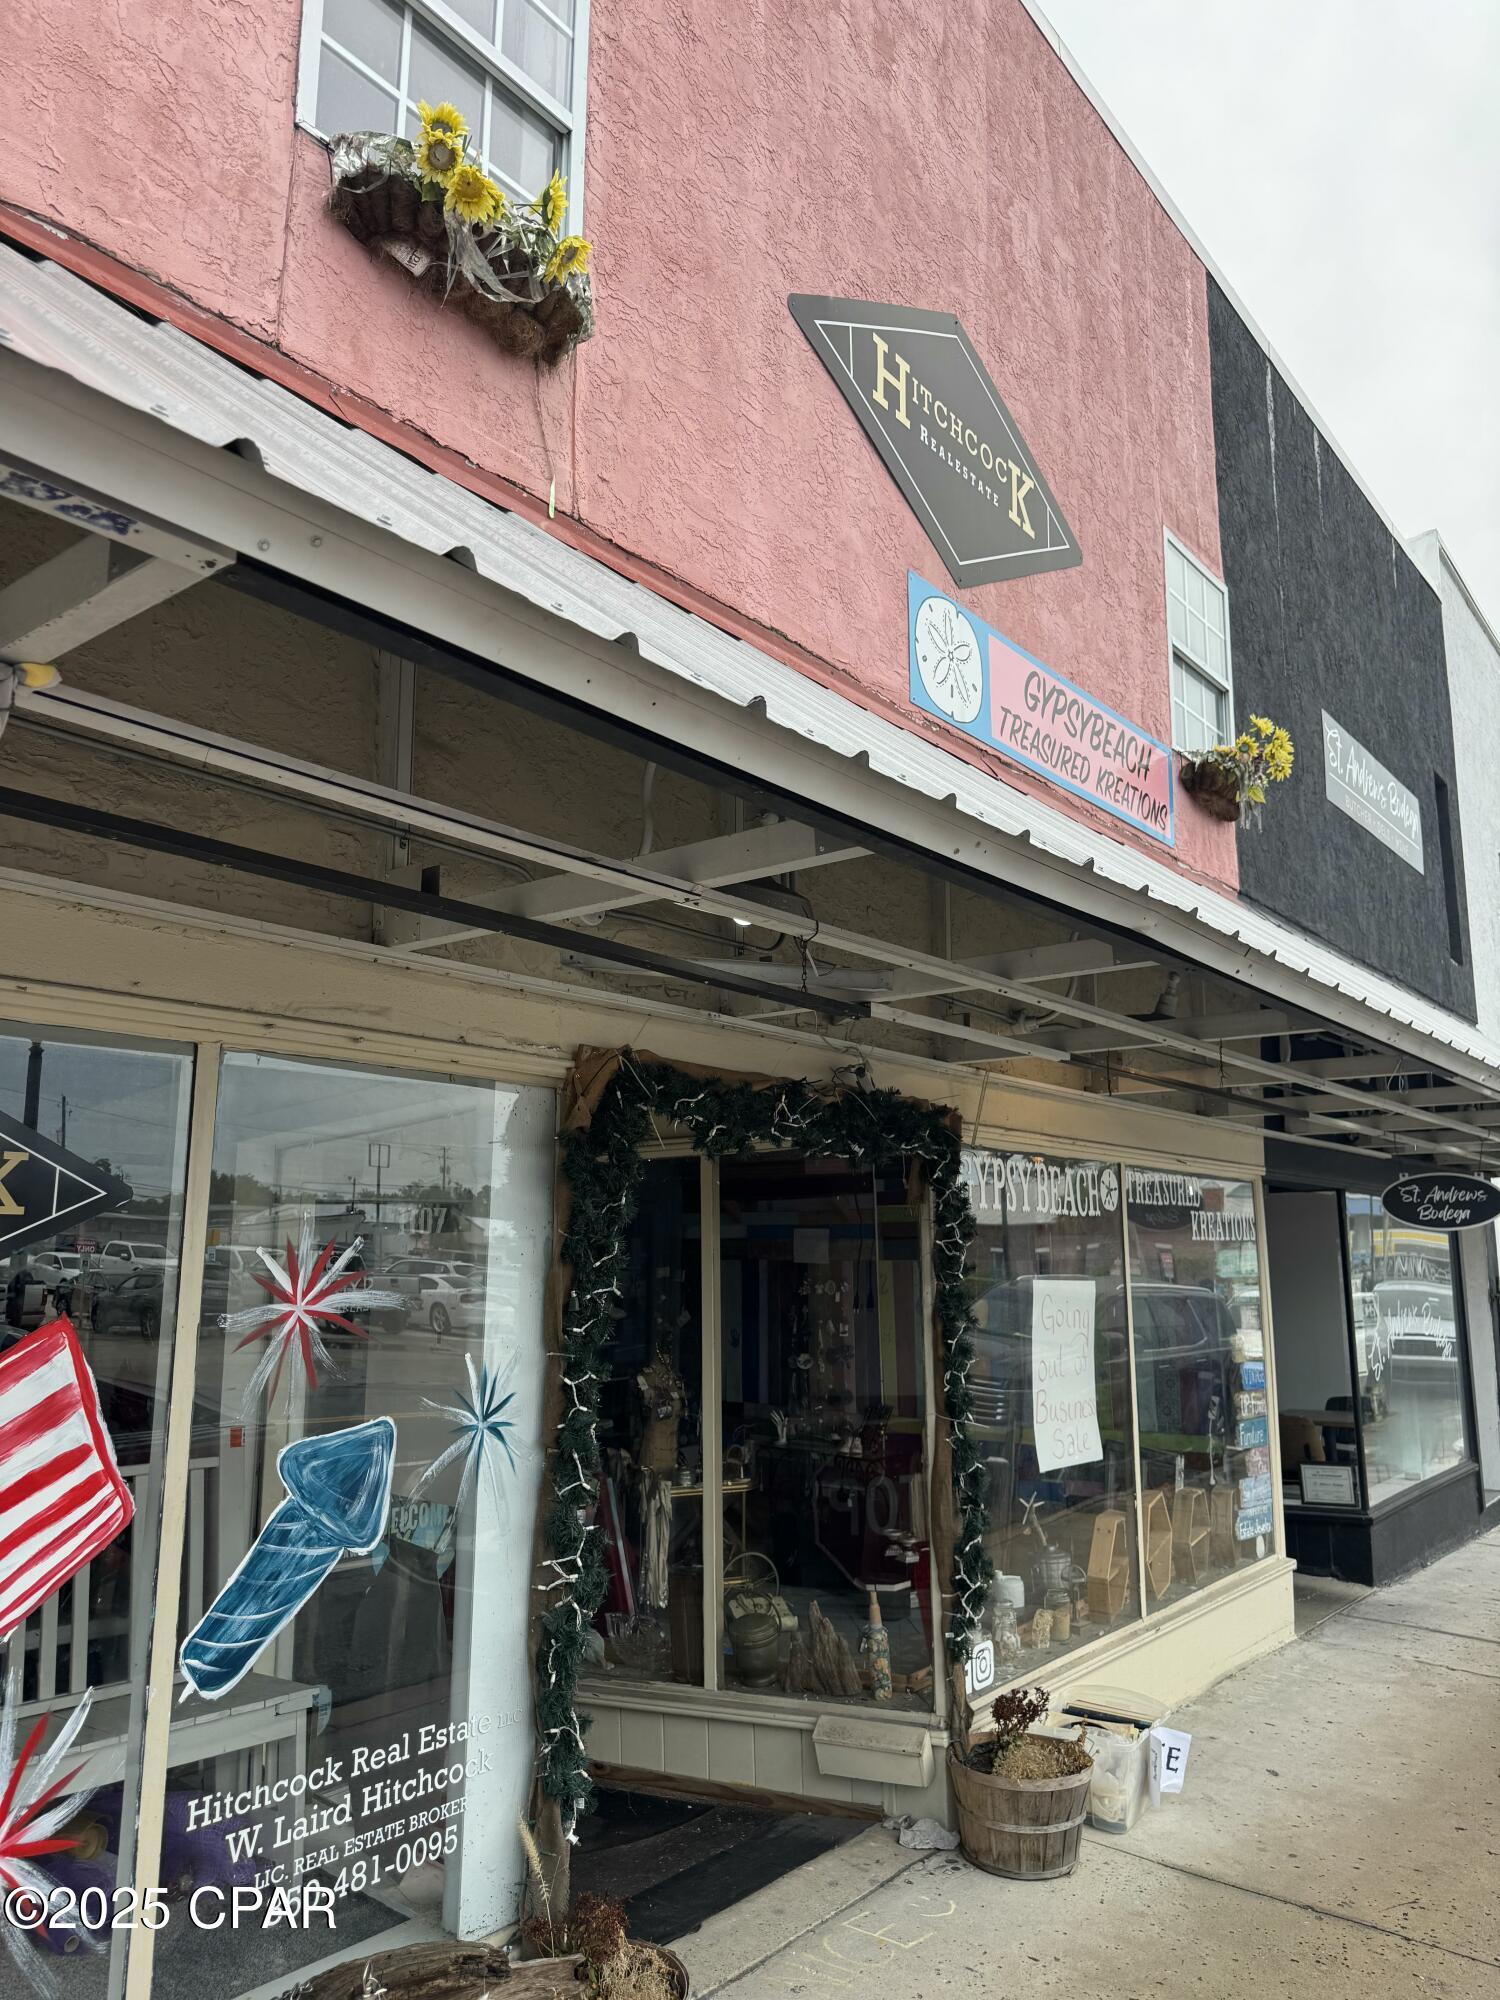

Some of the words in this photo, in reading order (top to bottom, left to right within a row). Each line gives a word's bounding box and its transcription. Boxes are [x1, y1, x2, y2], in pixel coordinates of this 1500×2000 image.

[872, 332, 1035, 539] HITCHCOCK
[1024, 671, 1152, 782] GYPSYBEACH
[1324, 722, 1343, 775] St.
[1000, 706, 1090, 784] TREASURED
[1095, 766, 1168, 831] KREATIONS
[1126, 1169, 1201, 1208] TREASURED
[1398, 1184, 1420, 1204] St.
[1424, 1185, 1488, 1203] Andrews
[1190, 1210, 1256, 1241] KREATIONS
[1417, 1204, 1471, 1224] Bodega
[1041, 1294, 1090, 1342] Going
[1038, 1344, 1065, 1382] out
[1052, 1428, 1091, 1460] Sale
[351, 1732, 411, 1777] Real
[417, 1712, 492, 1756] Estate
[225, 1823, 263, 1864] W.
[273, 1793, 352, 1849] Laird
[361, 1748, 494, 1818] Hitchcock
[254, 1863, 289, 1890] LIC.
[293, 1845, 339, 1878] REAL
[343, 1818, 405, 1858] ESTATE
[408, 1797, 469, 1830] BROKER
